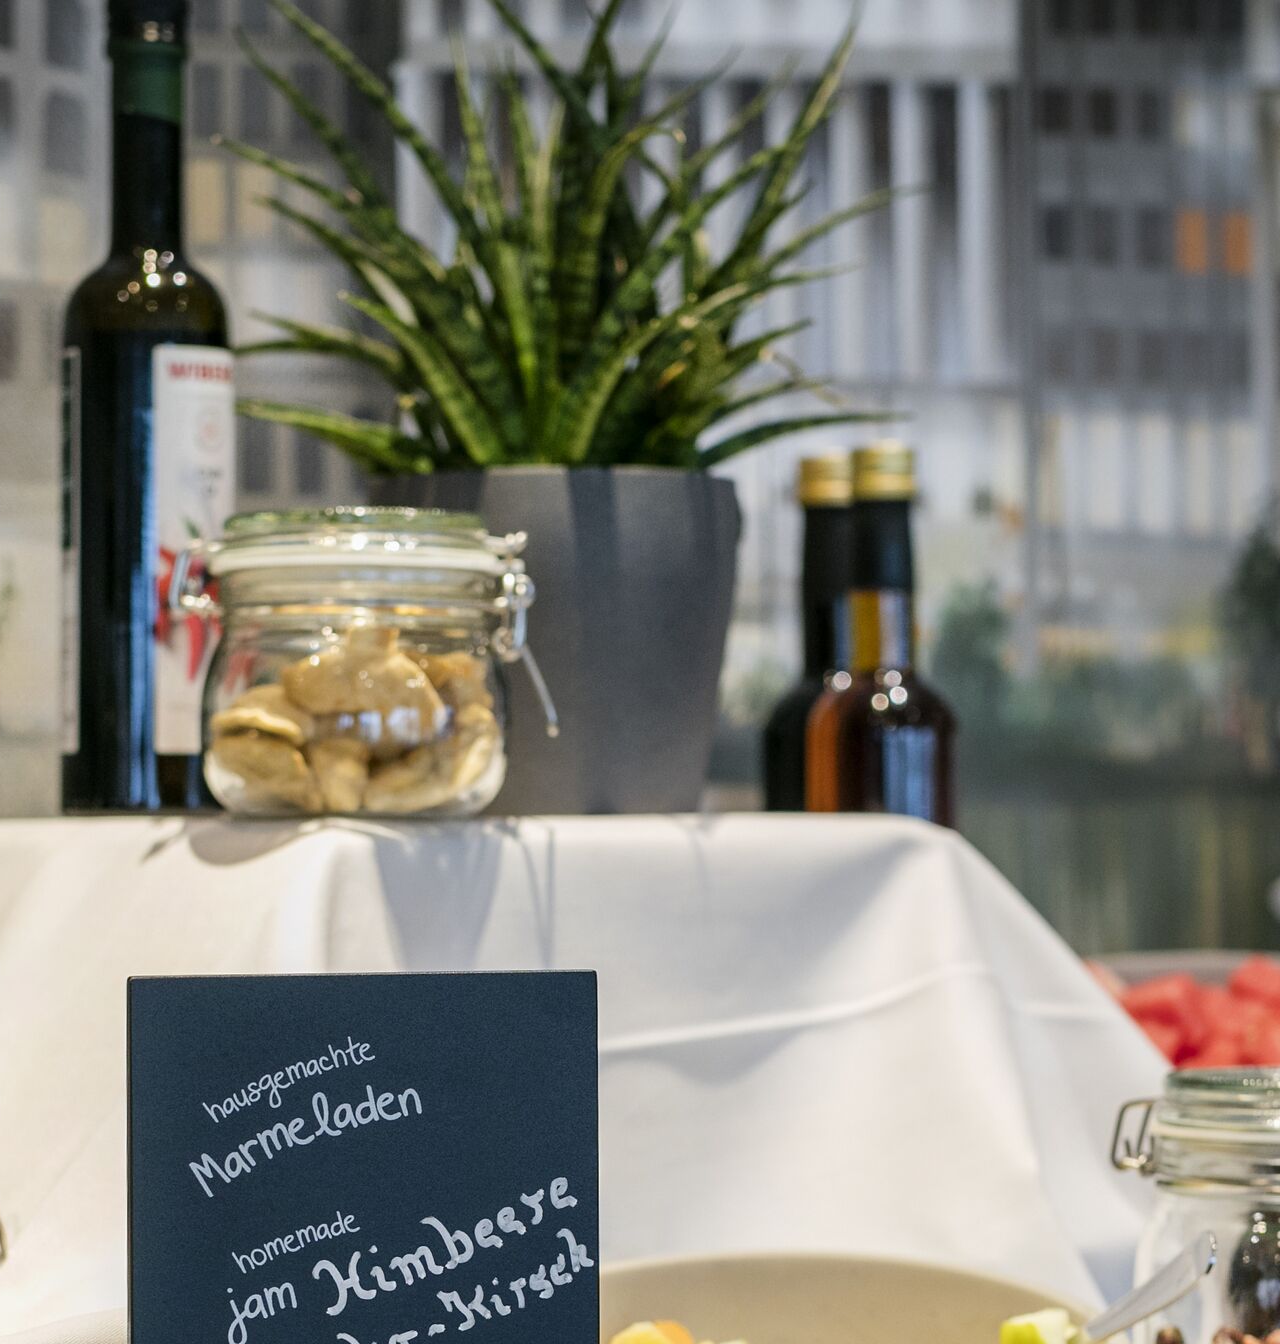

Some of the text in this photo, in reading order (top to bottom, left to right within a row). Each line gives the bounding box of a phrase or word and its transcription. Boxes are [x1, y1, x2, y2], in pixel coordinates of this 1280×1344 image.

[202, 1036, 376, 1123] hausgemachte
[188, 1085, 423, 1198] Marmeladen
[231, 1210, 361, 1274] homemade
